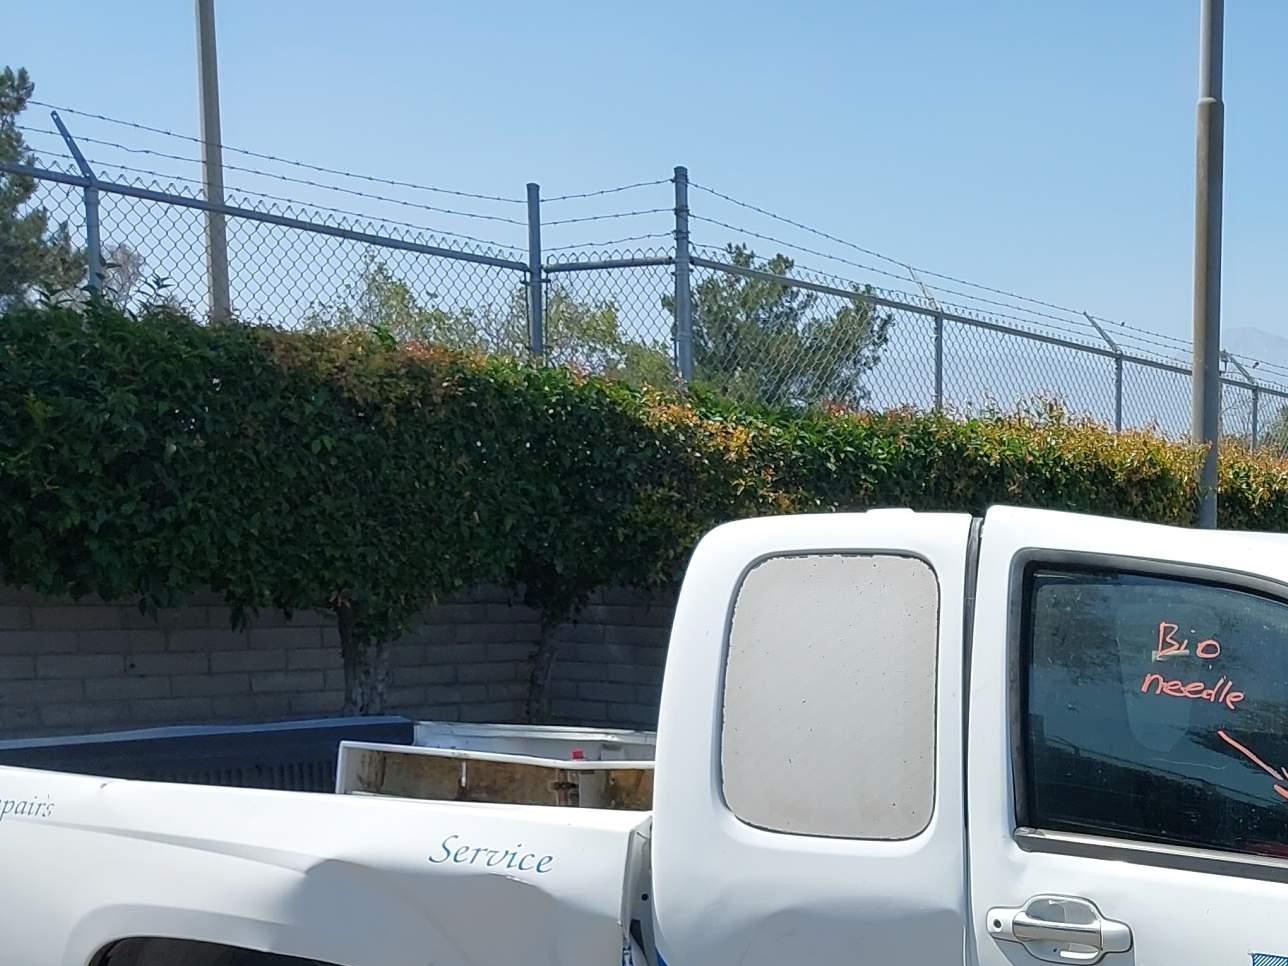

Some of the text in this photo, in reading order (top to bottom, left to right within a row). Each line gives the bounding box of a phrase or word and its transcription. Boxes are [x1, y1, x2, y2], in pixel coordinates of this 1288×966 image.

[1157, 621, 1221, 660] Bio
[1141, 674, 1244, 710] needle
[0, 795, 55, 822] pairs
[428, 834, 553, 873] Service
